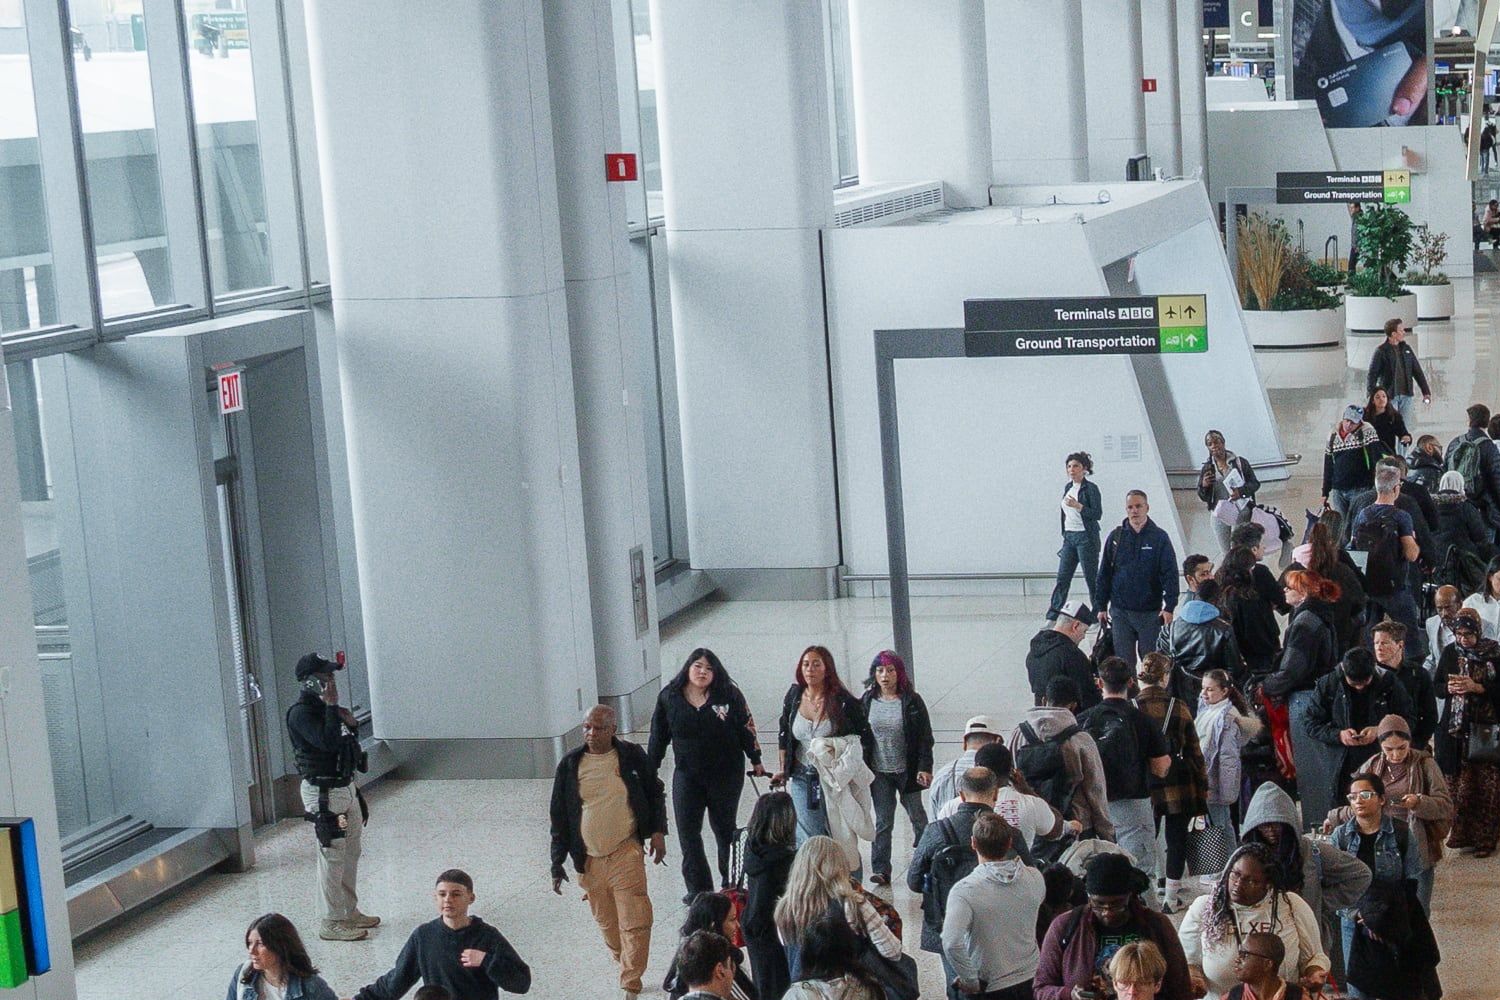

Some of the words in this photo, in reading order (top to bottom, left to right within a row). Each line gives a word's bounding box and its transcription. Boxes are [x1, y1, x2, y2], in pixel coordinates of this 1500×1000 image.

[1241, 11, 1252, 26] C
[1326, 175, 1360, 183] Terminals
[1304, 191, 1330, 199] Ground
[1331, 191, 1382, 200] Transportation
[1055, 308, 1115, 320] Terminals
[1016, 337, 1062, 350] Ground
[1064, 336, 1156, 351] Transportation
[221, 374, 240, 409] EXIT
